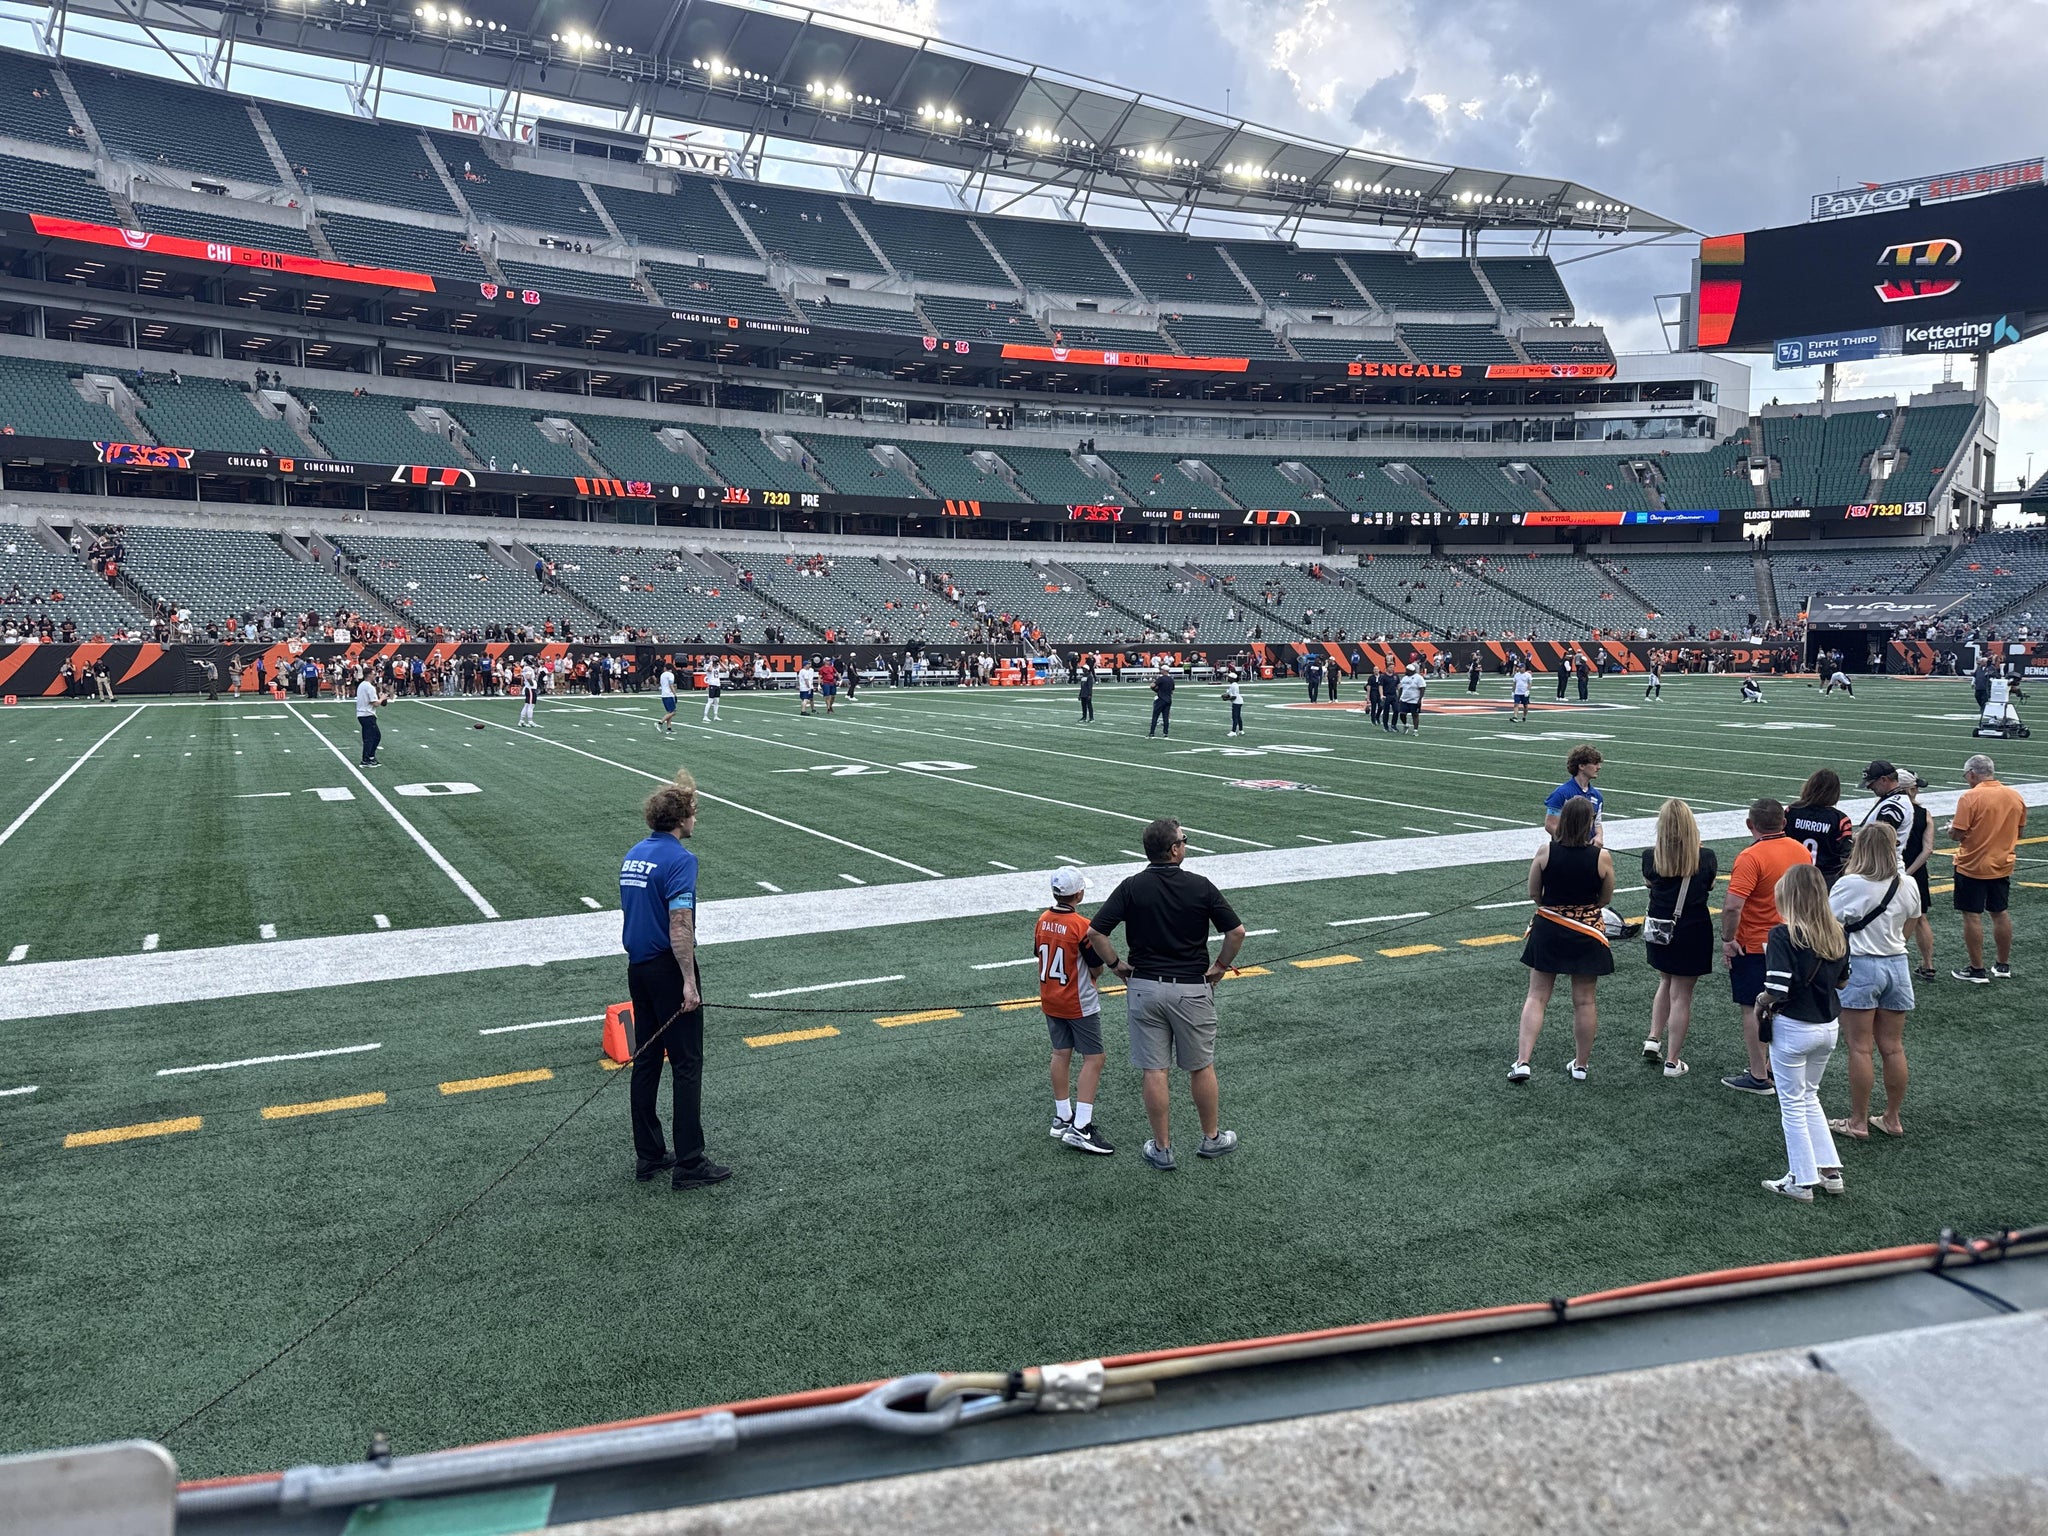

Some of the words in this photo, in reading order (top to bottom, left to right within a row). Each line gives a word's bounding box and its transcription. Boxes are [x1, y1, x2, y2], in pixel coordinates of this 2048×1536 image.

[1812, 184, 1924, 215] Paycor
[1928, 164, 2043, 198] STADIUM
[207, 243, 232, 262] CHI
[261, 252, 283, 269] CIN
[671, 311, 700, 322] CHICAGO
[702, 315, 721, 325] BEARS
[745, 320, 782, 332] CINCINNATI
[1906, 321, 1992, 342] Kettering
[1808, 339, 1839, 350] FIFTH
[1842, 335, 1878, 346] THIRD
[1928, 336, 1979, 350] HEALTH
[1104, 352, 1119, 365] CHI
[1135, 354, 1149, 366] CIN
[1808, 350, 1839, 359] BANK
[1348, 363, 1463, 377] BENGALS
[1582, 367, 1594, 375] SEP
[1596, 367, 1603, 375] 13
[228, 457, 268, 468] CHICAGO
[304, 462, 354, 474] CINCINNATI
[672, 486, 680, 498] 0
[698, 487, 706, 500] 0
[763, 491, 791, 506] 73:20
[801, 493, 820, 507] PRE
[1744, 511, 1770, 519] CLOSED
[1771, 510, 1811, 519] CAPTIONING
[1872, 504, 1902, 516] 73:20
[1908, 503, 1921, 514] 25
[1188, 512, 1220, 520] CINCINNATI
[1856, 601, 1937, 611] Kroger
[1795, 818, 1831, 835] BURROW
[621, 860, 657, 875] BEST
[1042, 920, 1068, 935] DALTON
[1038, 943, 1069, 985] 14
